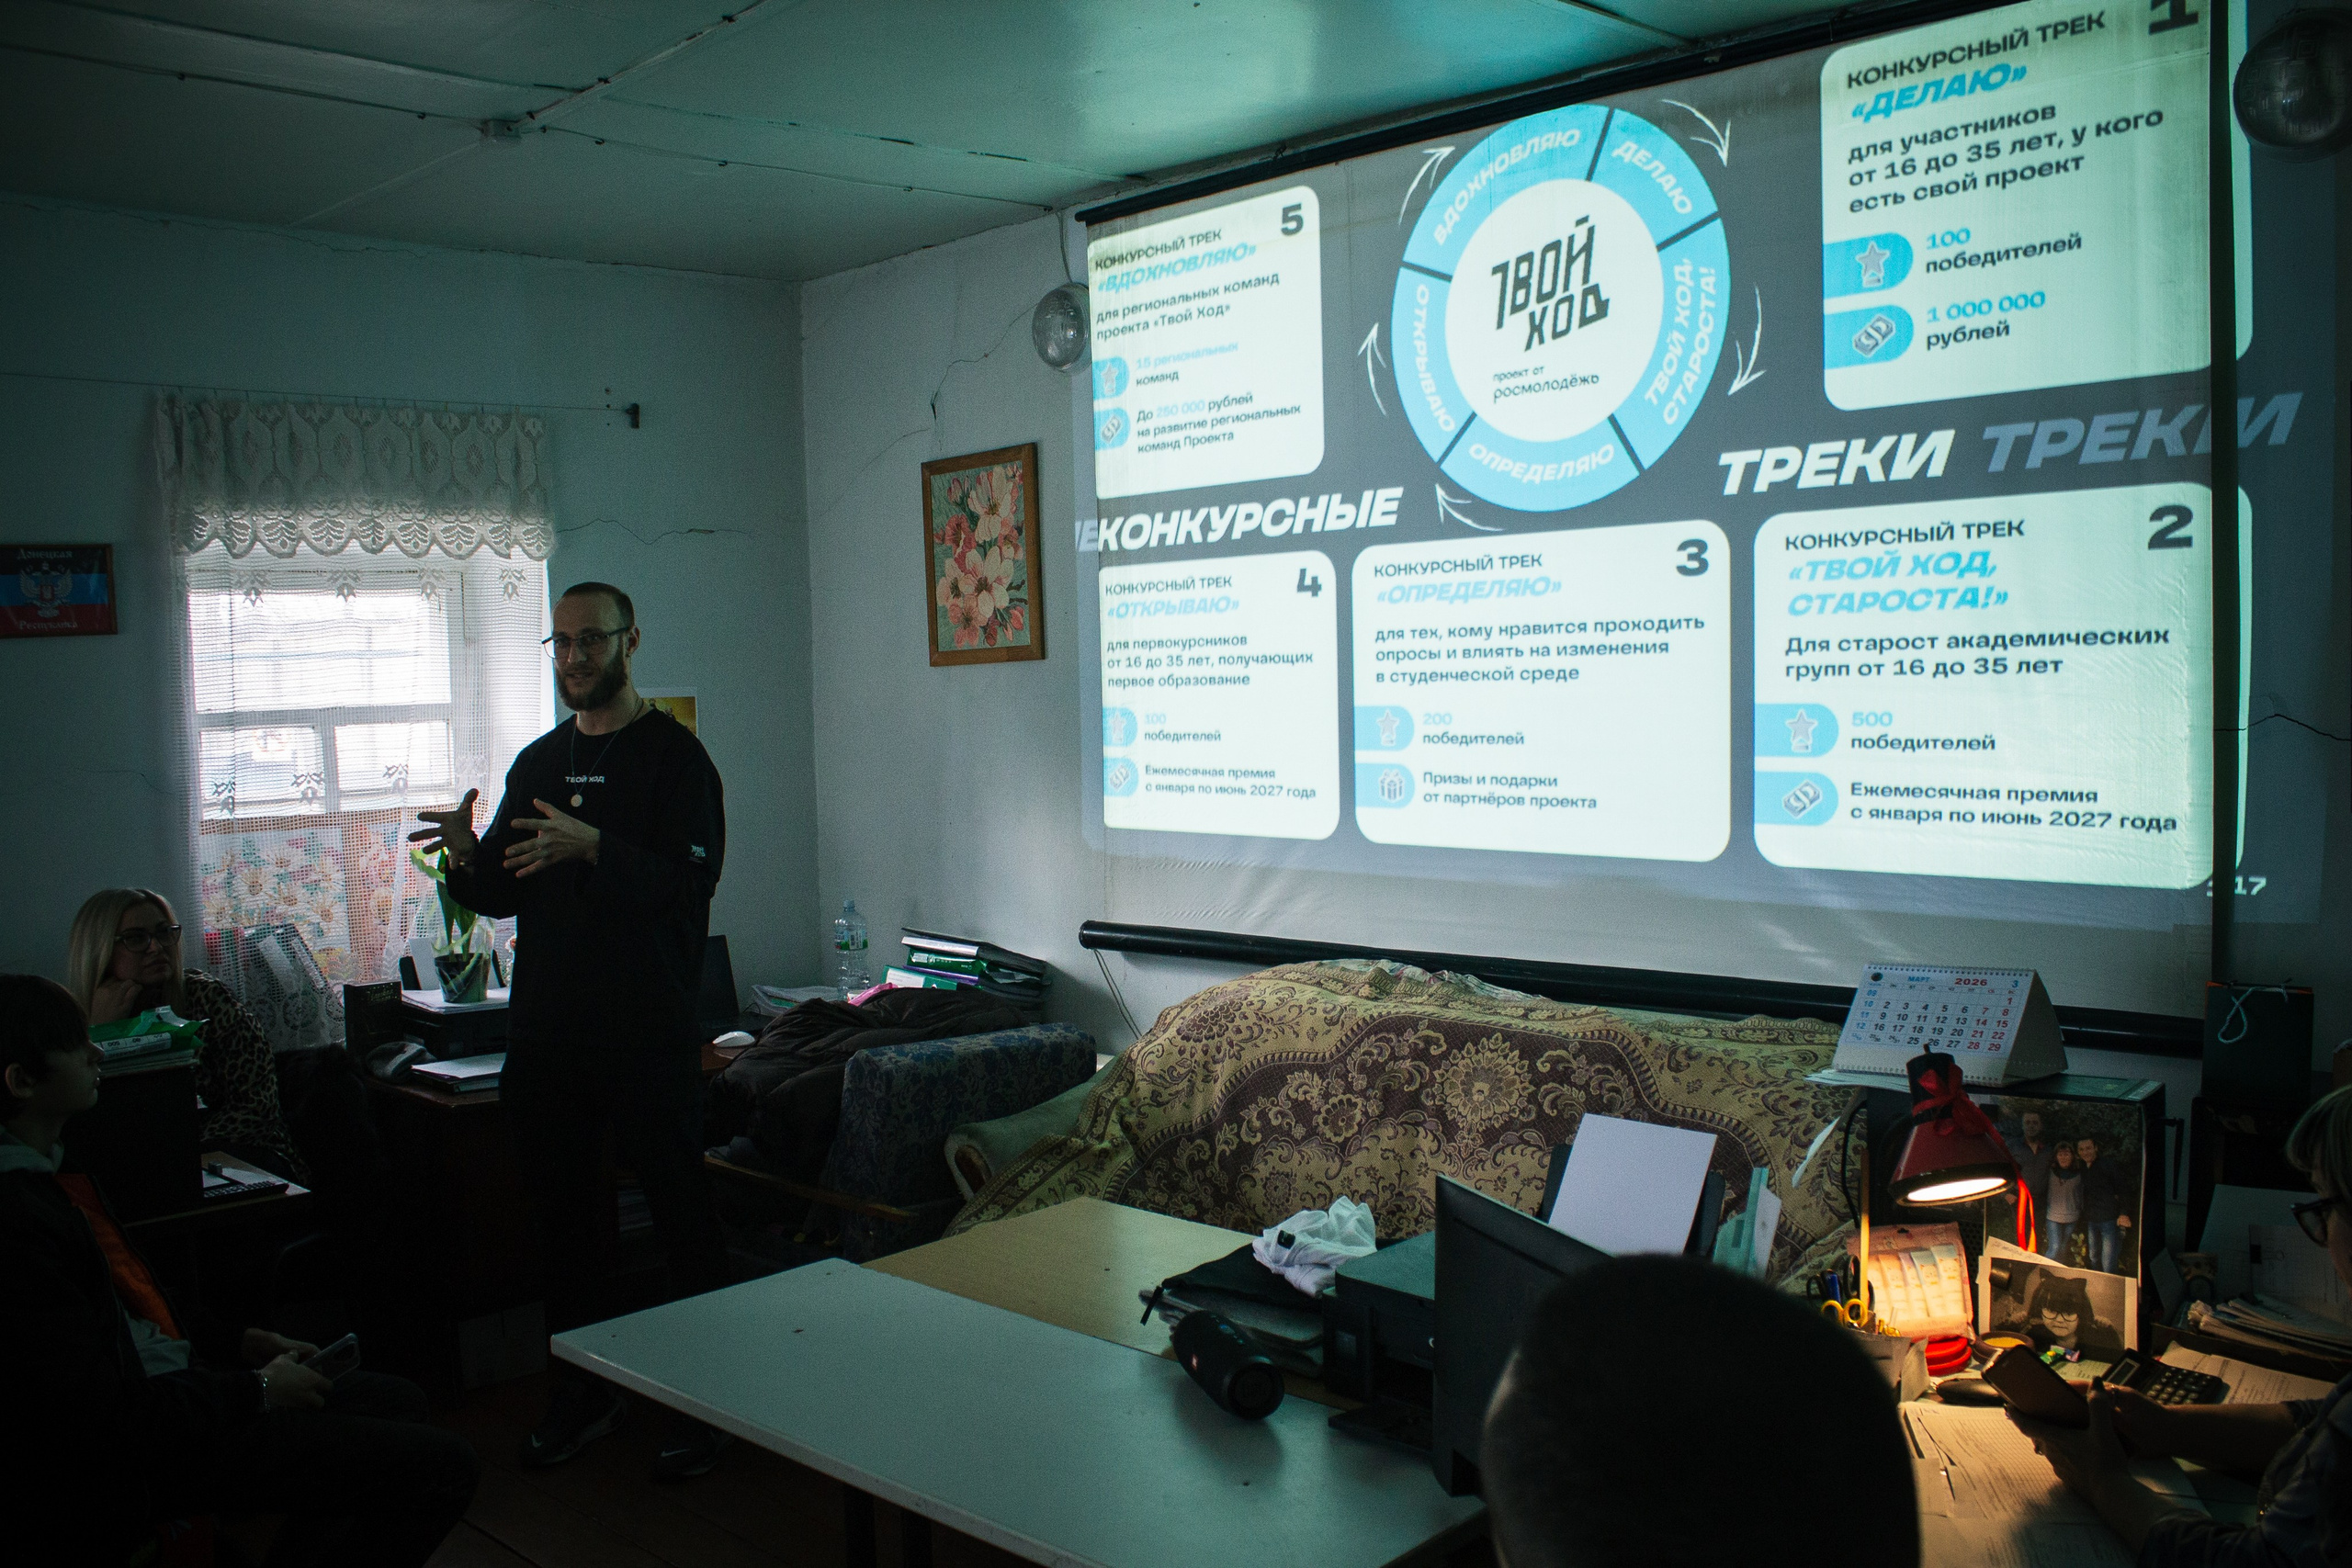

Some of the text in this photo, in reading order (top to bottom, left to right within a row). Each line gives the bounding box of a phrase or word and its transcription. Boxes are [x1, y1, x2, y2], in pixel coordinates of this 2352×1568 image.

[1848, 11, 2106, 89] КОНКУРСНЫЙ ТРЕК
[1851, 62, 2028, 123] «ДЕЛАЮ»
[1849, 105, 2056, 164] для участников
[1849, 109, 2165, 186] от 16 до 35 лет, у кого
[1433, 129, 1580, 245] ВДОХНОВЛЯЮ
[1612, 140, 1692, 215] ДЕЛАЮ
[1849, 155, 2085, 213] есть свой проект
[1281, 203, 1304, 236] 5
[1095, 229, 1222, 270] КОНКУРСНЫЙ ТРЕК
[1926, 228, 1971, 251] 100
[1926, 232, 2082, 274] победителей
[1098, 243, 1257, 294] «ВДОХНОВЛЯЮ»
[1491, 214, 1596, 330] ТВОЙ
[1096, 273, 1280, 325] для региональных команд
[1927, 290, 2046, 322] 1 000 000
[1096, 303, 1231, 341] проекта «Твой Ход»
[1524, 284, 1610, 352] ХОД
[1645, 258, 1692, 408] ТВОЙ ХОД,
[1663, 266, 1716, 425] СТАРОСТА!
[1927, 319, 2010, 350] рублей
[1154, 342, 1238, 368] региональных
[1413, 284, 1456, 433] ОТКРЫВАЮ
[1136, 370, 1180, 388] команд
[1493, 366, 1544, 382] проект от
[1493, 372, 1600, 404] росмолодёжь
[1136, 409, 1154, 424] До
[1207, 392, 1253, 412] рублей
[1153, 404, 1301, 440] развитие региональных
[1137, 431, 1234, 454] команд Проекта
[1719, 391, 2303, 496] ТРЕКИ ТРЕКИ
[1469, 443, 1615, 484] ОПРЕДЕЛЯЮ
[1098, 487, 1403, 551] КОНКУРСНЫЕ
[2147, 504, 2194, 550] 2
[1785, 519, 2025, 551] КОНКУРСНЫЙ ТРЕК
[1374, 554, 1543, 578] КОНКУРСНЫЙ ТРЕК
[1676, 538, 1709, 577] 3
[1788, 548, 1996, 582] «ТВОЙ ХОД,
[1105, 576, 1232, 596] КОНКУРСНЫЙ ТРЕК
[1296, 568, 1321, 597] 4
[1377, 576, 1562, 604] «ОПРЕДЕЛЯЮ»
[1107, 595, 1239, 619] «ОТКРЫВАЮ»
[1788, 586, 2009, 616] СТАРОСТА!»
[1107, 635, 1248, 652] для первокурсников
[1375, 617, 1705, 643] для тех, кому нравится проходить
[1785, 629, 2169, 656] Для старост академических
[1107, 652, 1314, 670] от 16 до 35 лет, получающих
[1375, 641, 1669, 663] опросы и влиять на изменения
[1108, 673, 1250, 690] первое образование
[1390, 665, 1579, 686] студенческой среде
[1785, 658, 2064, 682] групп от 16 до 35 лет
[1422, 713, 1453, 726] 200
[1851, 712, 1893, 727] 500
[1145, 730, 1222, 742] победителей
[1422, 731, 1525, 747] победителей
[1850, 734, 1996, 753] победителей
[565, 775, 605, 784] ТВОЙ ХОД
[1145, 765, 1275, 780] Ежемесячная премия
[1423, 773, 1558, 790] Призы подарки
[1155, 784, 1317, 800] января по июнь 2027 года
[1423, 791, 1597, 810] от партнёров проекта
[1850, 782, 2098, 806] Ежемесячная премия
[1850, 807, 2177, 832] с января по июнь 2027 года
[1954, 977, 1988, 987] 2026
[1874, 1023, 1885, 1032] 16
[1893, 1024, 1905, 1032] 17
[1932, 1027, 1944, 1035] 19
[1951, 1028, 1963, 1037] 20
[1972, 1030, 1984, 1038] 21
[1992, 1032, 2005, 1040] 22
[1897, 1013, 1908, 1021] 10
[1936, 1016, 1948, 1024] 12
[1956, 1017, 1967, 1025] 13
[1996, 1020, 2008, 1028] 15
[1946, 1040, 1961, 1048] 27
[1967, 1041, 1980, 1050] 28
[1987, 1043, 2001, 1052] 29
